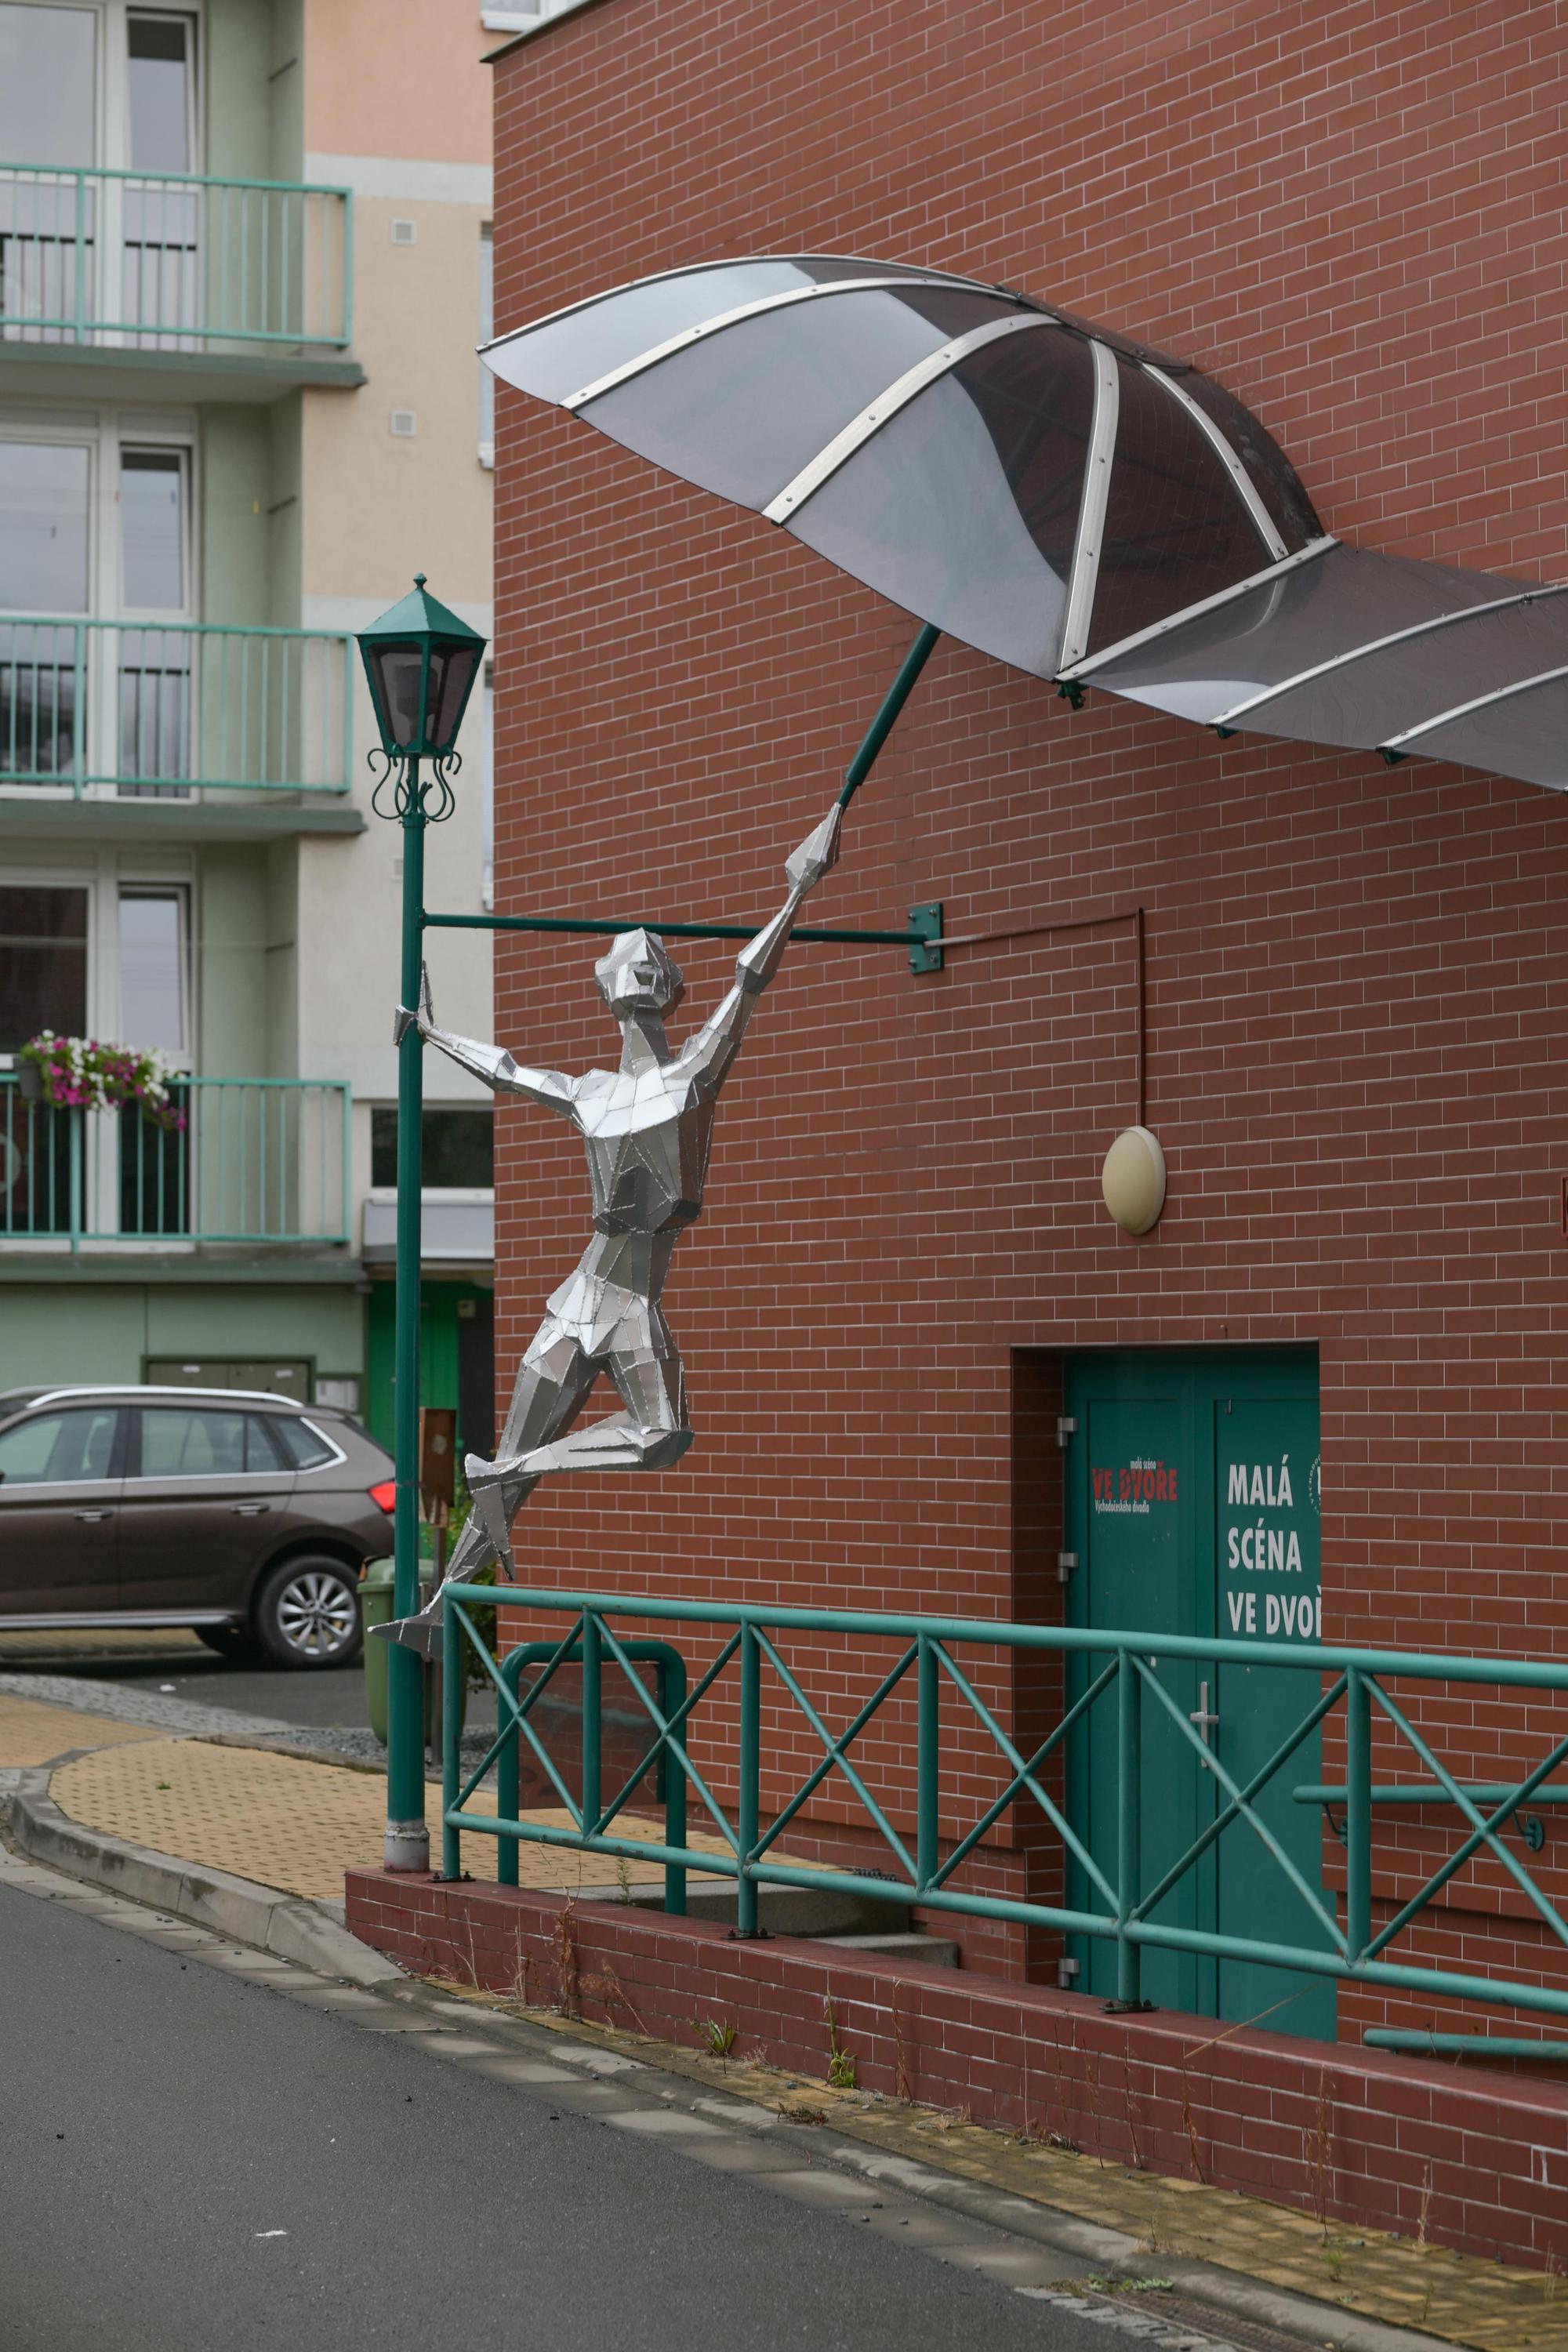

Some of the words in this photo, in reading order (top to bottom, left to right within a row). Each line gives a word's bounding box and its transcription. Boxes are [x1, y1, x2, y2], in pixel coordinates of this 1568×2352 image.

[1091, 1468, 1112, 1500] VE
[1120, 1461, 1178, 1501] DVOŘE
[1229, 1454, 1293, 1507] MALÁ
[1228, 1518, 1302, 1572] SCÉNA
[1228, 1592, 1256, 1633] VE
